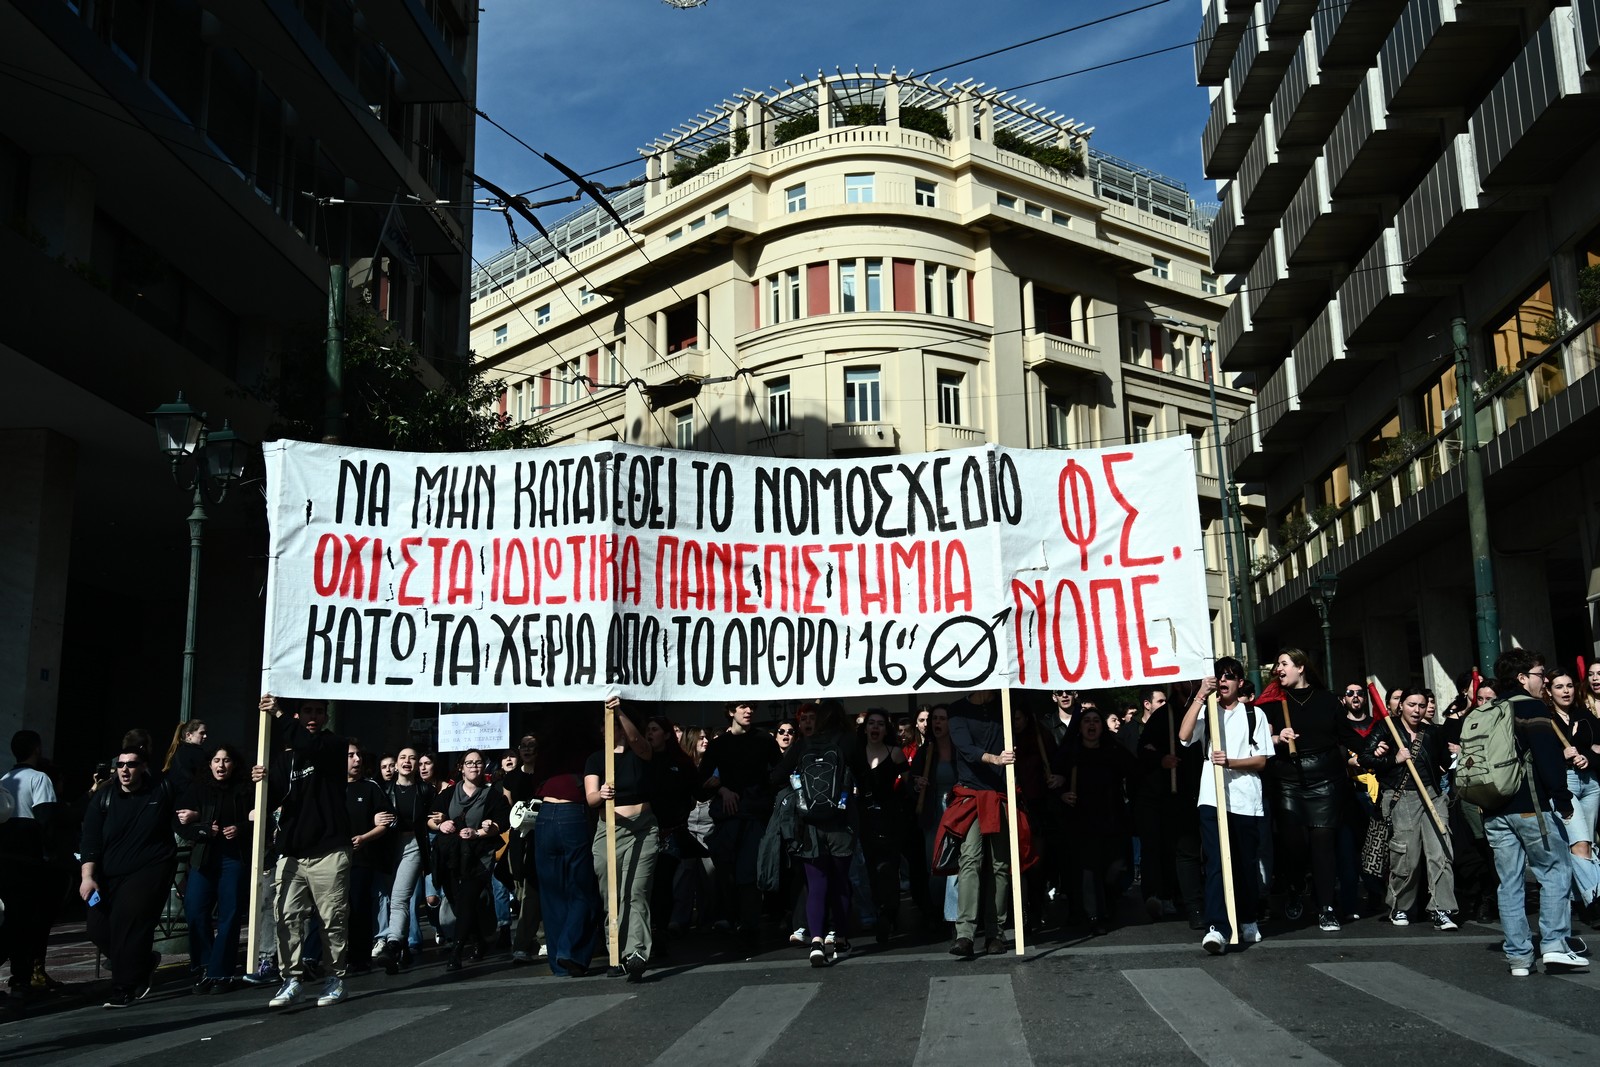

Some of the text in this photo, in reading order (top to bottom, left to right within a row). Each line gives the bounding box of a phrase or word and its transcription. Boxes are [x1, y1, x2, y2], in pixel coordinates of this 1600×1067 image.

[336, 450, 1022, 538] ΝΑ ΜΗΝ ΚΑΤΑΤΕΘΕΙ ΤΟ ΝΟΜΟΣΧΕΔΙΟ
[314, 533, 973, 616] ΟΧΙ ΣΤΑ ΙΔΙΩΤΙΚΑ ΠΑΝΕΠΙΣΤΗΜΙΑ
[303, 605, 416, 686] ΚΑΤΩ
[431, 614, 480, 686] ΤΑ
[491, 613, 596, 687] ΧΕΡΙΑ
[606, 612, 660, 686] ΑΠΟ
[672, 616, 714, 686] ΤΟ
[722, 617, 838, 687] ΑΡΘΡΟ
[1012, 575, 1180, 685] ΝΟΠΕ
